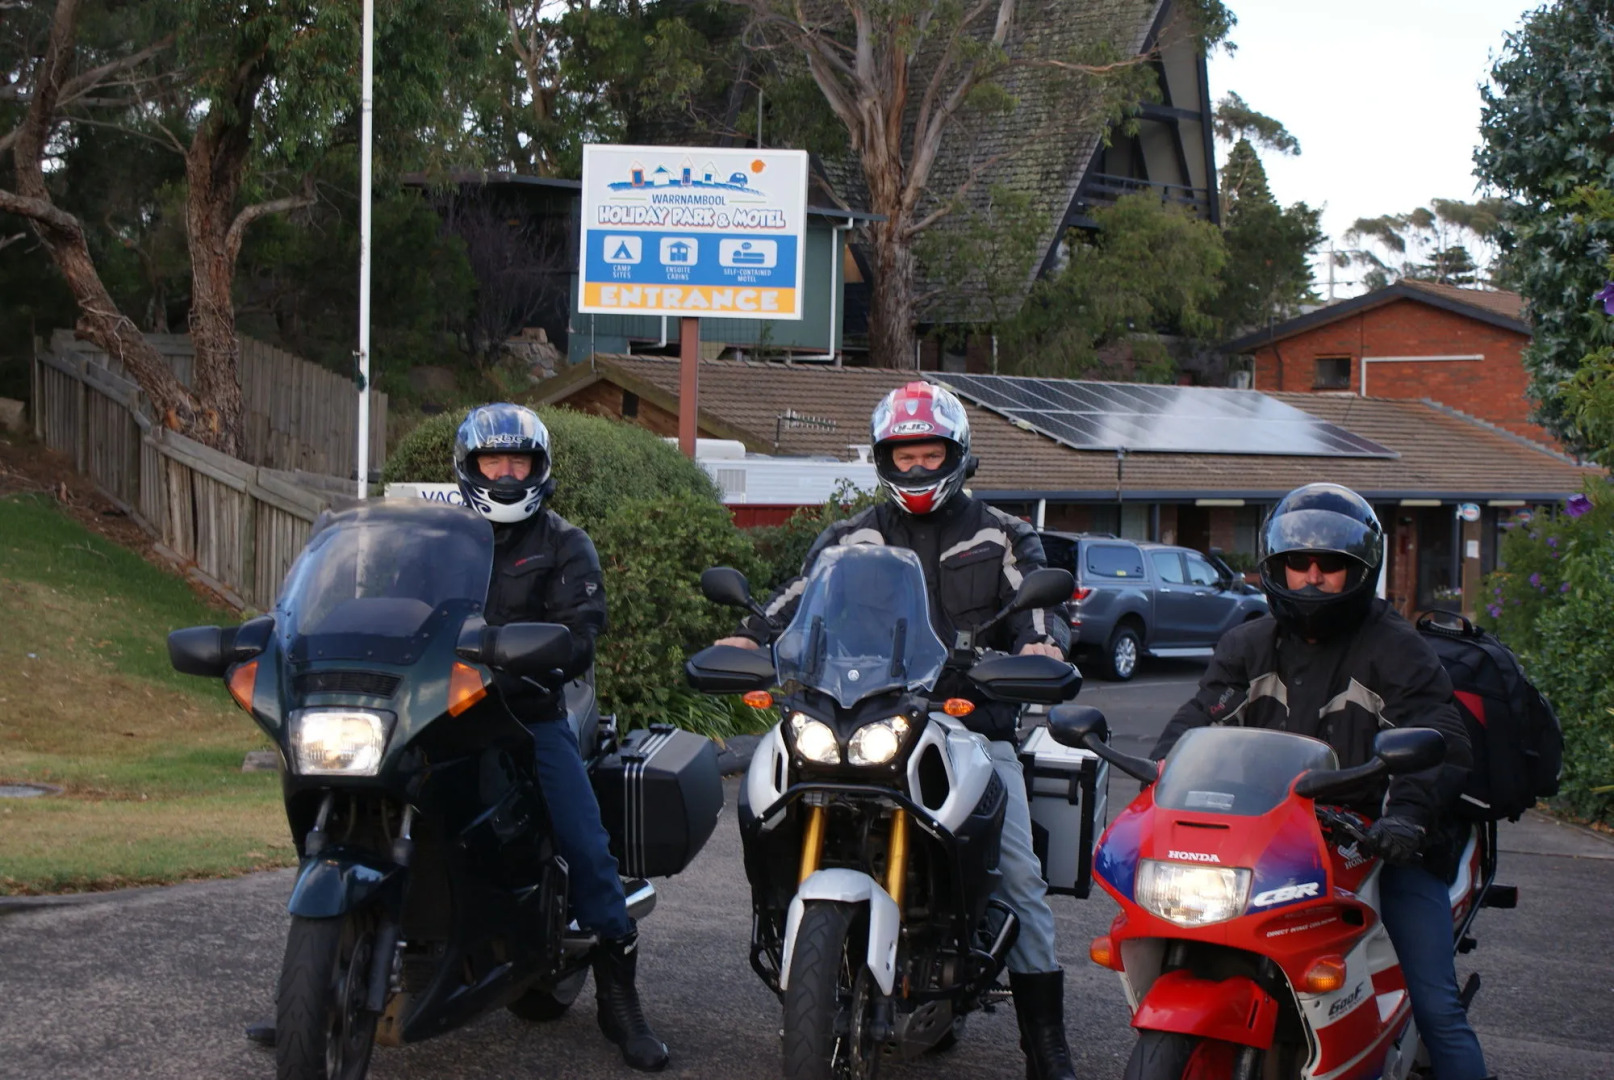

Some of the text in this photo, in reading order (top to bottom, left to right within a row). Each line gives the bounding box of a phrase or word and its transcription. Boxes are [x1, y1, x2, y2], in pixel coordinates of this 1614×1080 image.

[652, 194, 726, 206] WARRNAMBOOL
[598, 205, 786, 229] HOLIDAY PARK & MOTEL
[613, 265, 632, 273] CAMP
[665, 266, 691, 274] ENSUITE
[723, 268, 772, 277] SELF-CONTAINED
[613, 272, 631, 280] SITES
[667, 273, 690, 281] CABINS
[737, 275, 757, 283] MOTEL
[600, 287, 779, 311] ENTRANCE
[1167, 850, 1221, 863] HONDA
[1253, 881, 1320, 907] CBR
